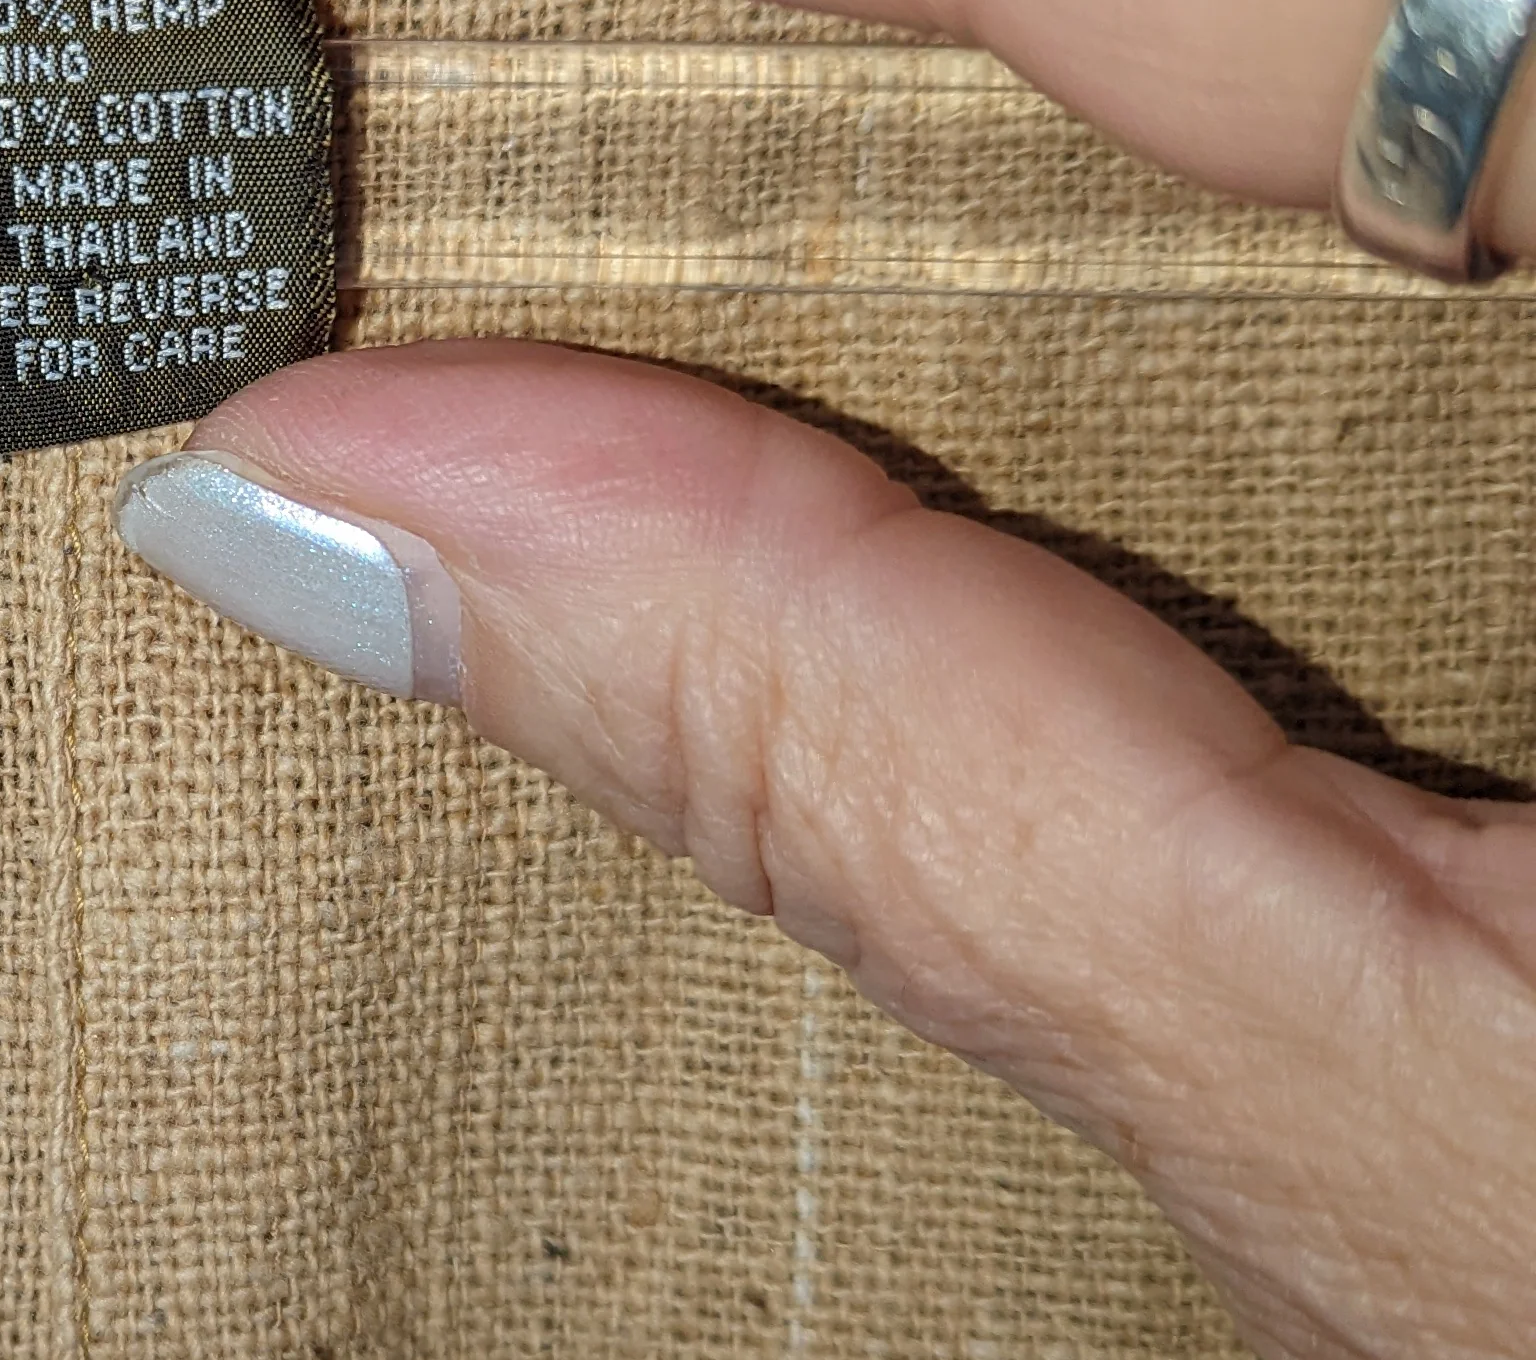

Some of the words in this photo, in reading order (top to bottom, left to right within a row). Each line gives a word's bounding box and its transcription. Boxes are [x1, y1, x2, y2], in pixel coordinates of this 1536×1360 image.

[96, 85, 293, 145] COTTON
[12, 158, 153, 209] MADE
[187, 152, 234, 200] IN
[7, 210, 254, 270] THAILAND
[75, 265, 292, 326] REVERSE
[15, 338, 100, 383] FOR
[123, 321, 247, 372] CARE
